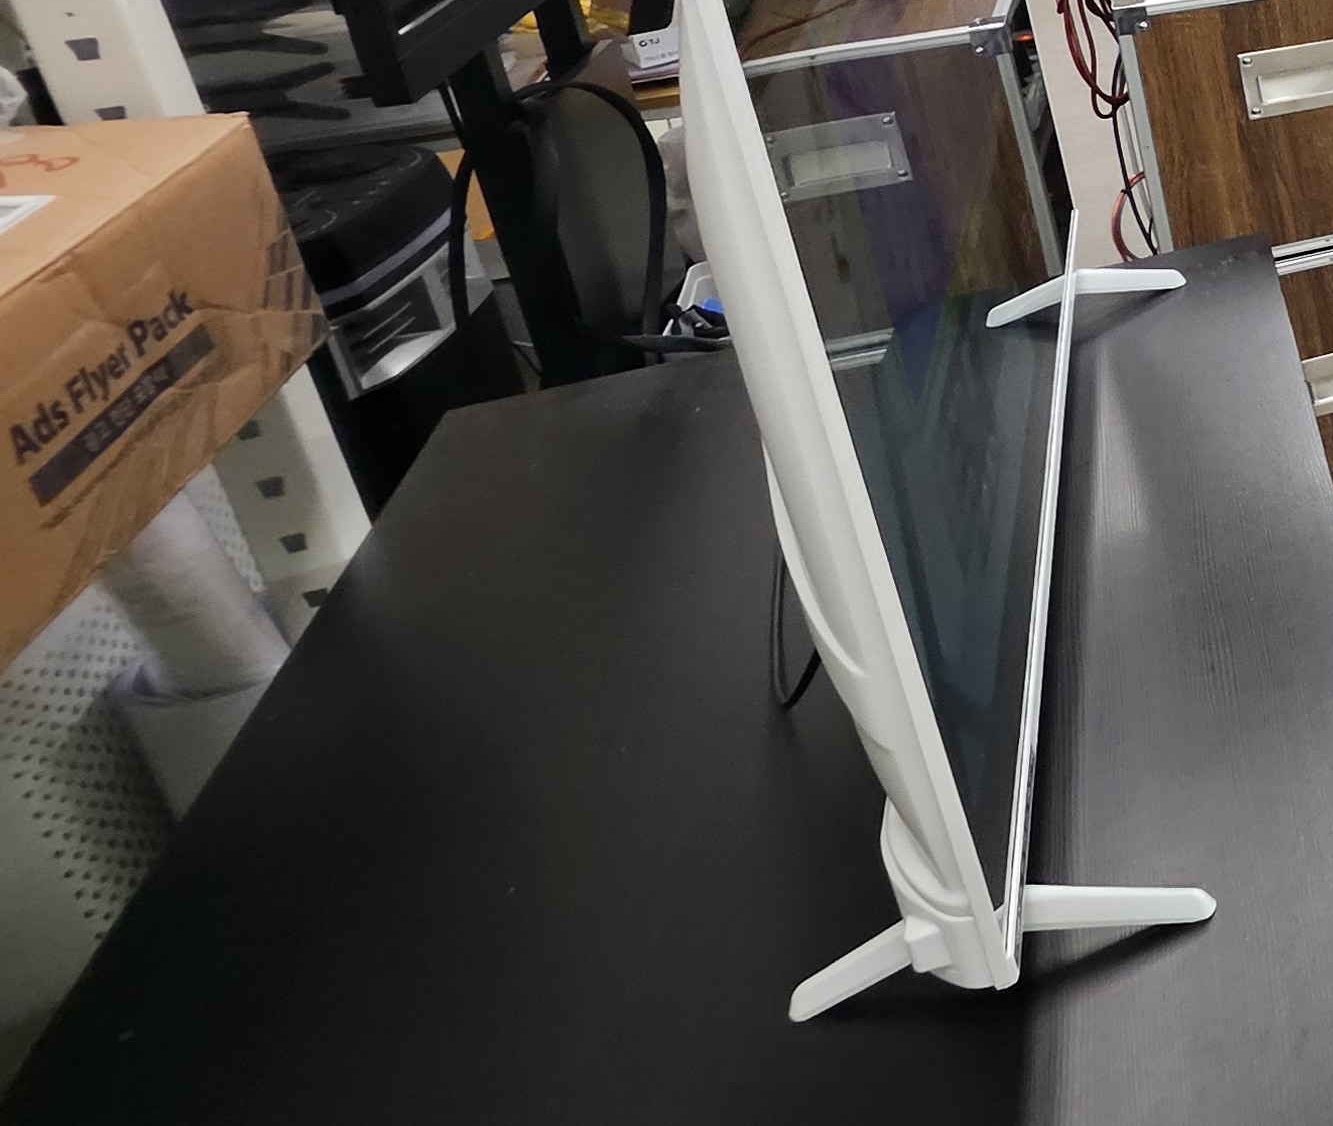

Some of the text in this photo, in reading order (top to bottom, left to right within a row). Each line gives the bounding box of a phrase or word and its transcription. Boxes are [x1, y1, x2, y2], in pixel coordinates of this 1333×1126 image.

[9, 401, 69, 466] Ads
[64, 342, 132, 415] Flyer
[127, 288, 195, 358] Pack
